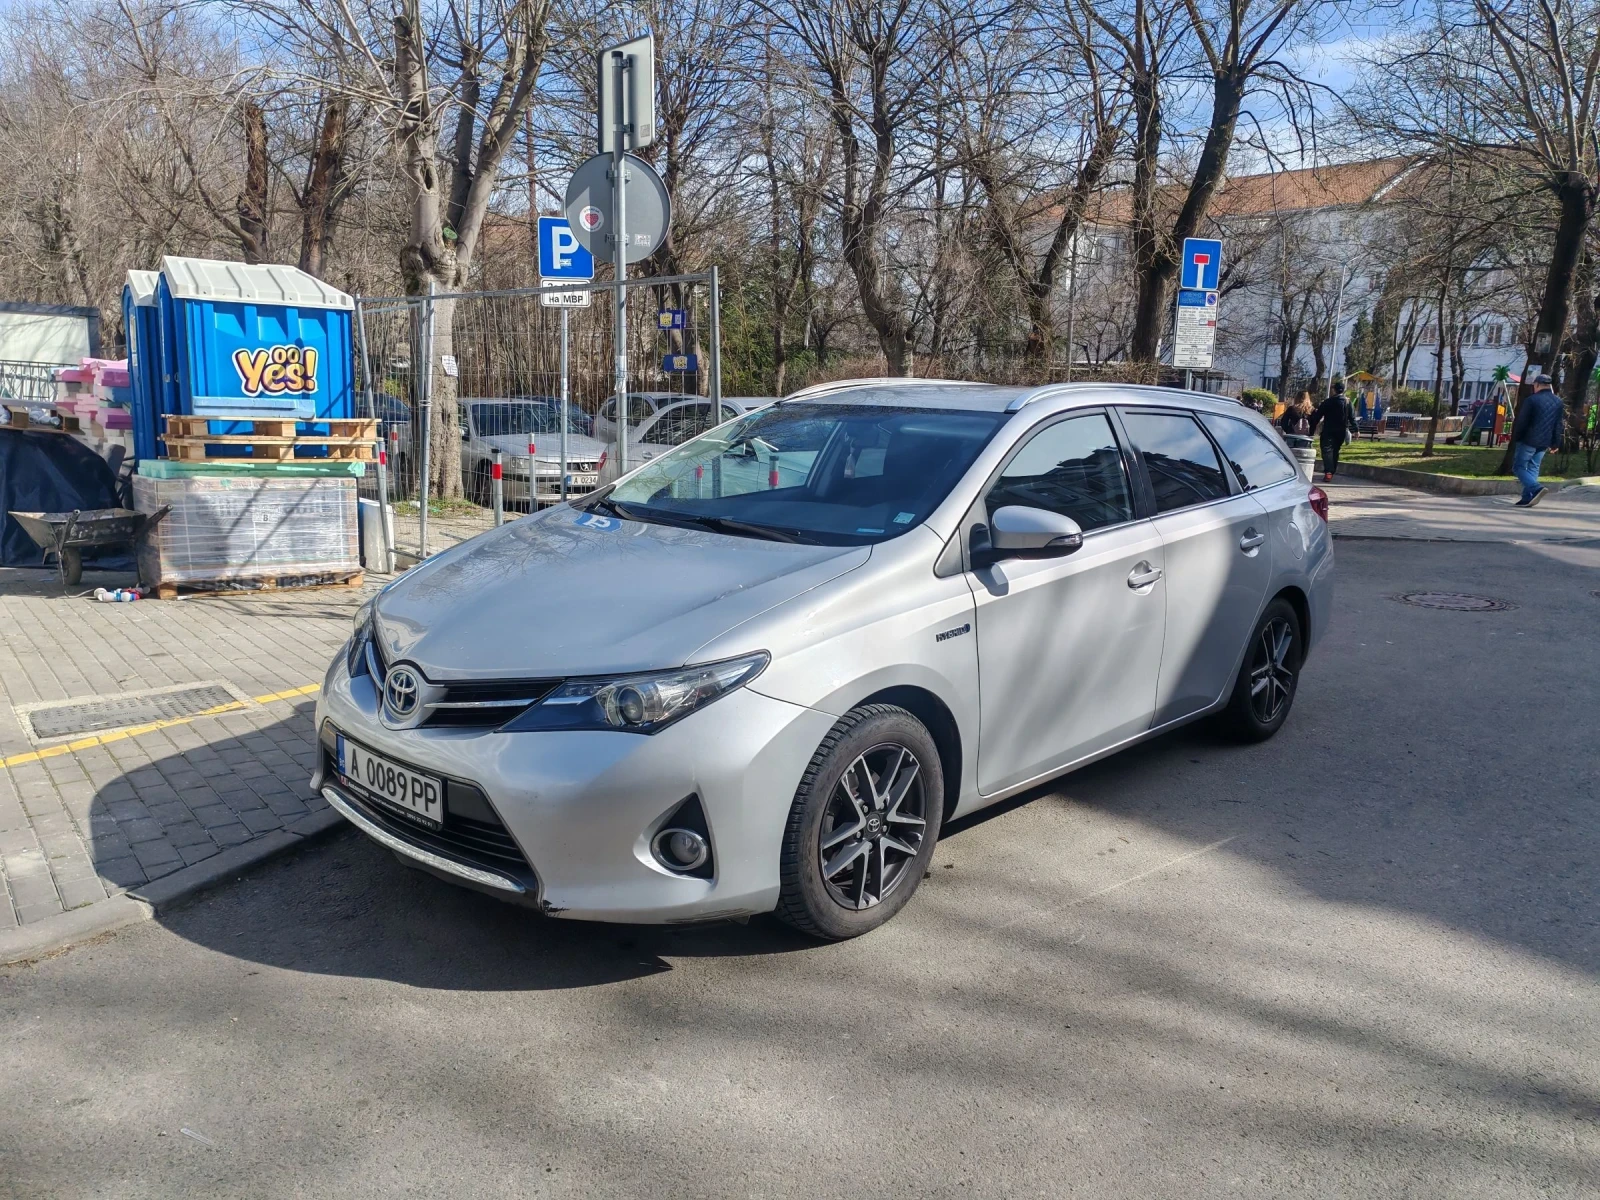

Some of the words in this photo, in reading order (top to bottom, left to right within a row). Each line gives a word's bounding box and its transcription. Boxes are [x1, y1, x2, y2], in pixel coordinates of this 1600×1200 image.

[563, 295, 583, 303] МВР
[351, 748, 360, 779] A
[367, 757, 408, 802] 0089
[411, 776, 437, 812] PP
